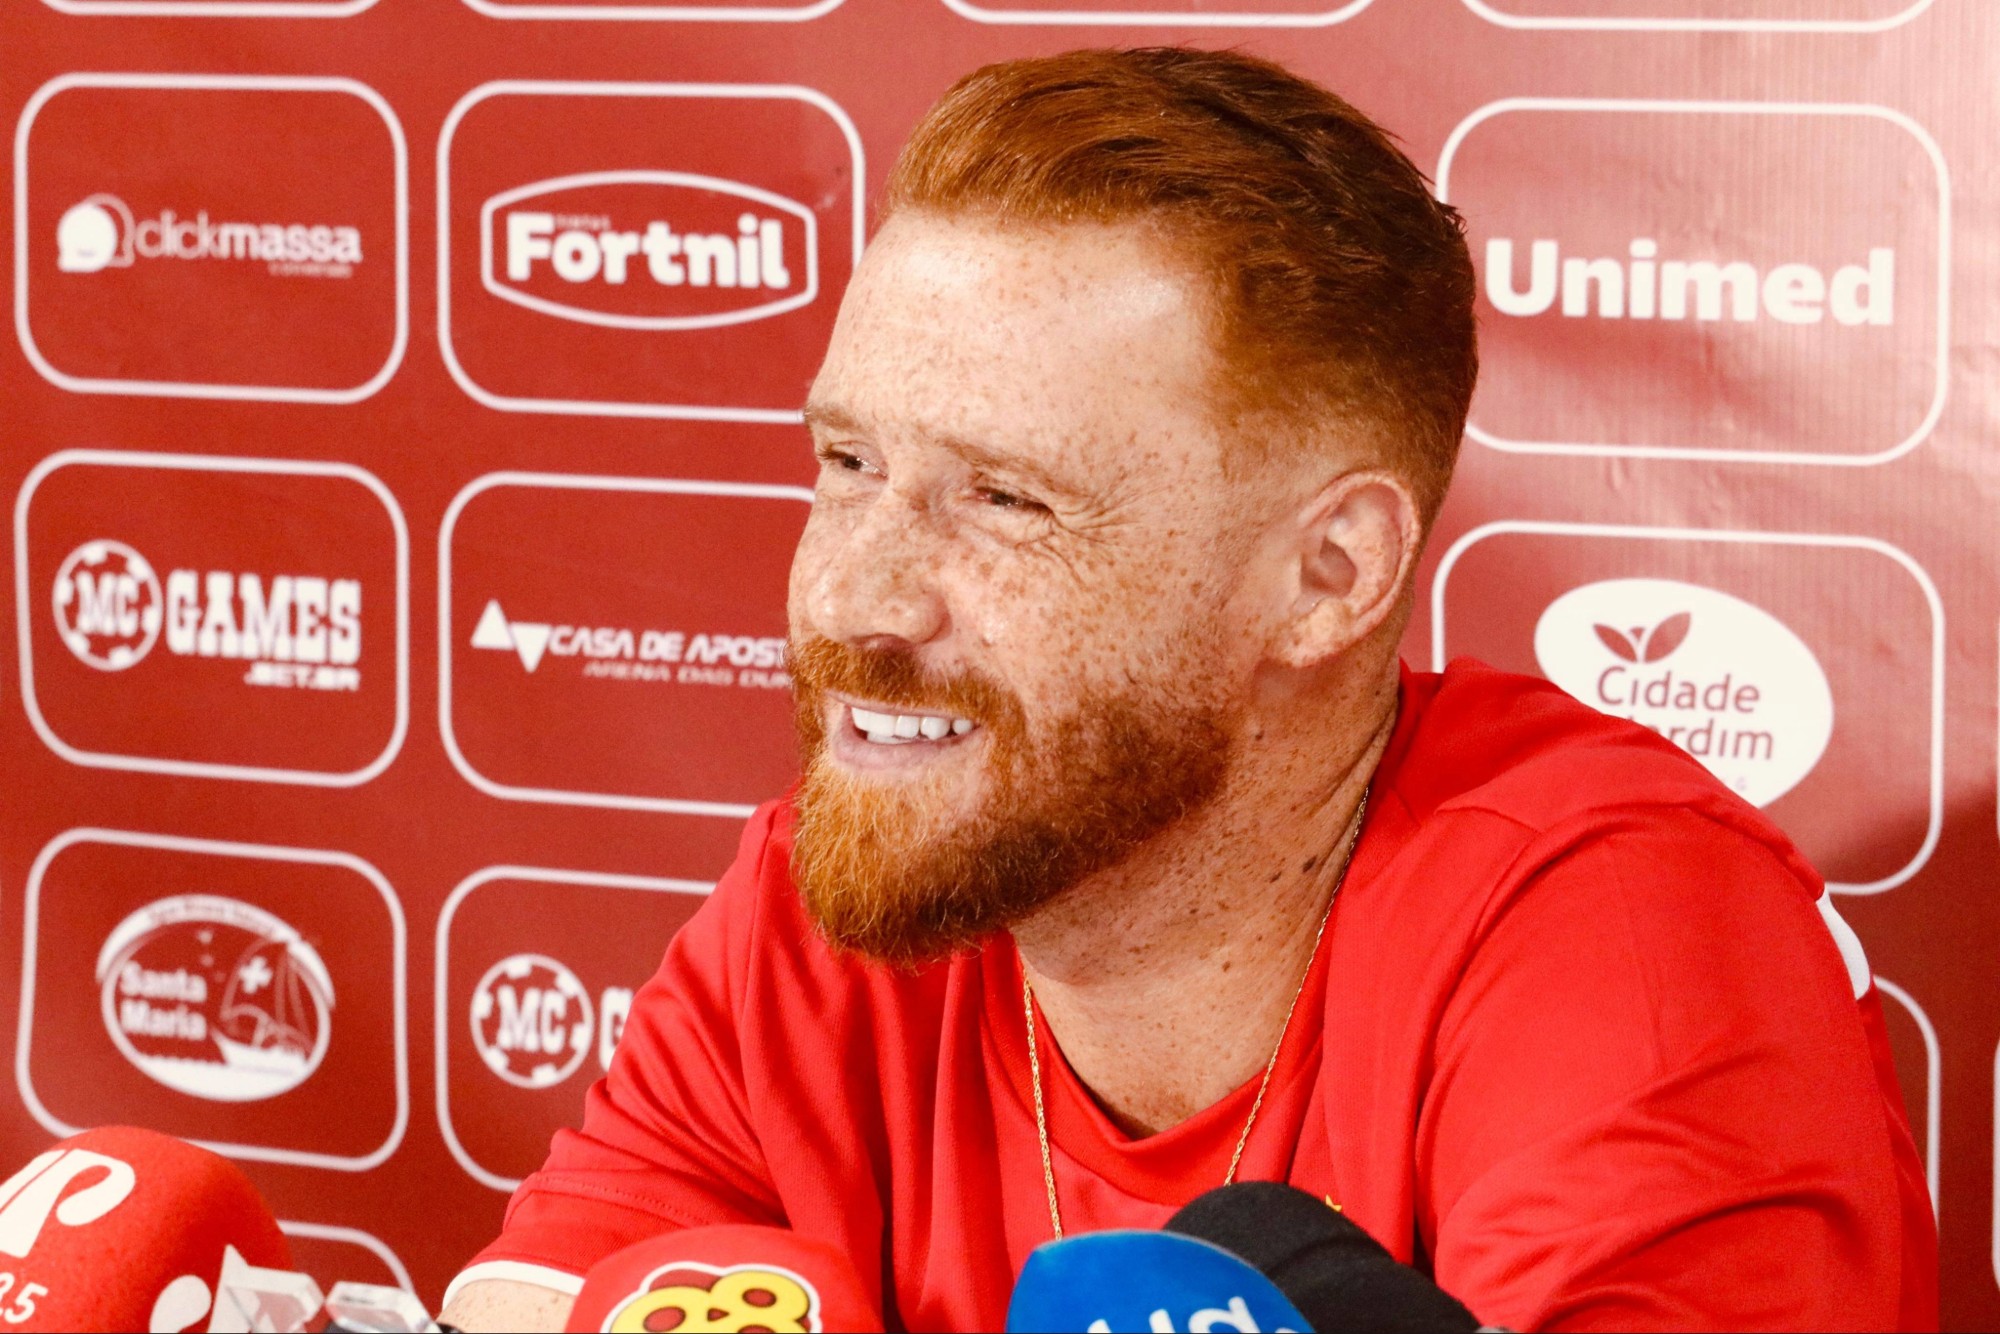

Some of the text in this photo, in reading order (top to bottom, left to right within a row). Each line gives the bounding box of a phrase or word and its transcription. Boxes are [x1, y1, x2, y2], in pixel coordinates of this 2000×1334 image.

[135, 209, 363, 263] clickmassa
[506, 211, 791, 289] Fortnil
[1485, 238, 1895, 326] Unimed
[76, 568, 361, 664] MC GAMES
[549, 625, 635, 660] CASA
[639, 630, 685, 661] DE
[1596, 666, 1760, 714] Cidade
[1640, 717, 1774, 760] rdim
[120, 960, 207, 1003] Santa
[120, 999, 207, 1041] Maria
[497, 985, 567, 1055] MC
